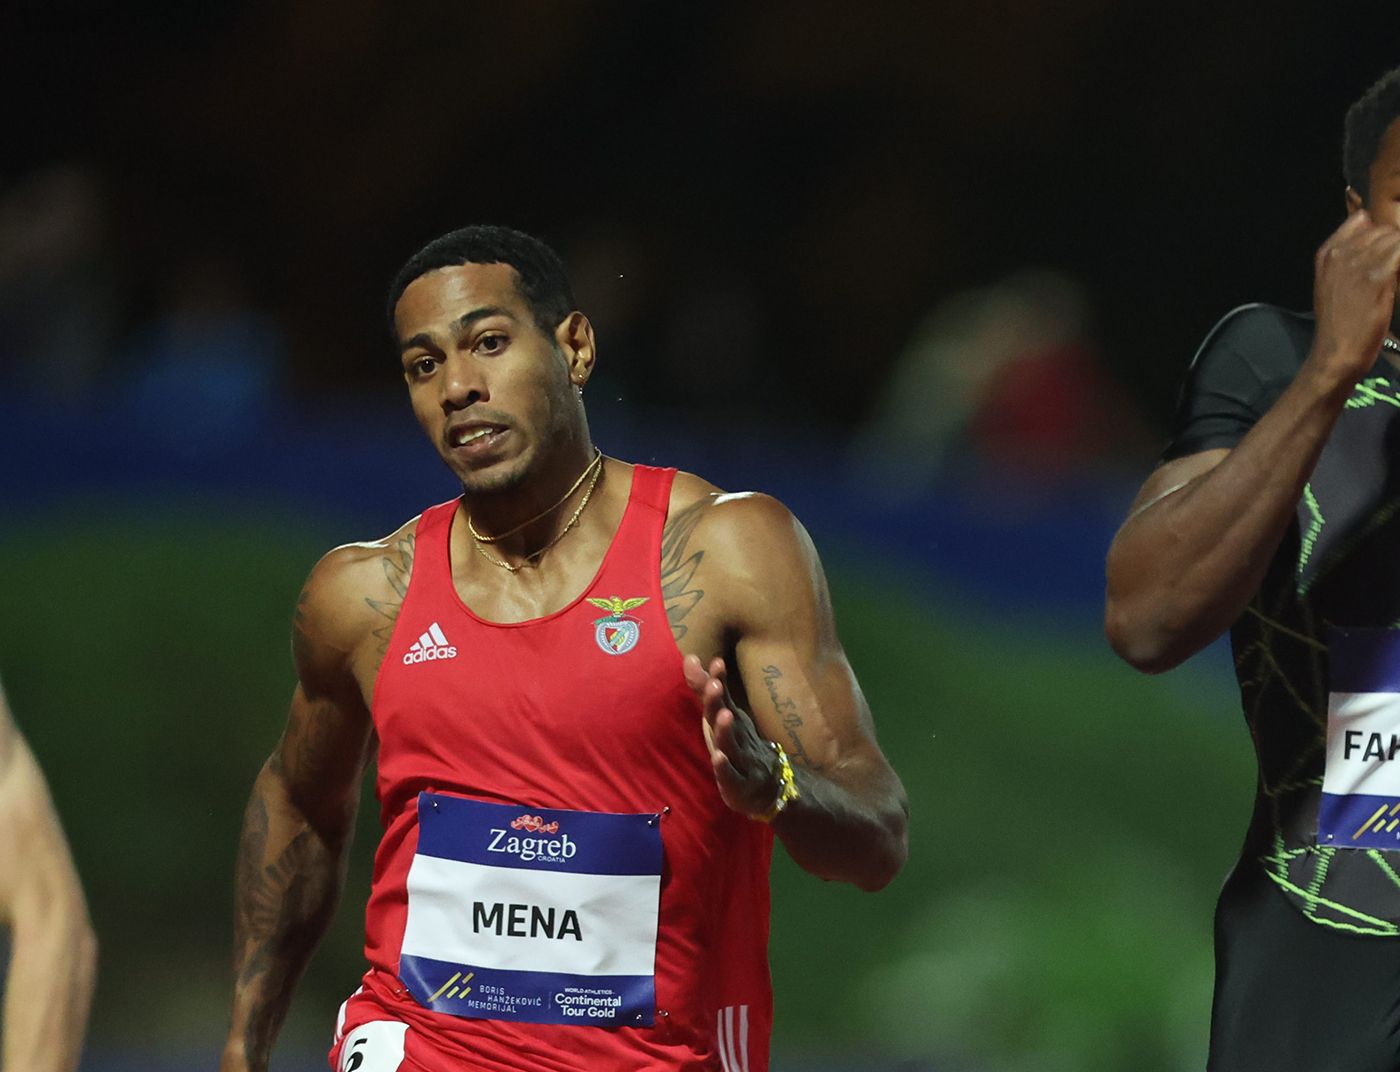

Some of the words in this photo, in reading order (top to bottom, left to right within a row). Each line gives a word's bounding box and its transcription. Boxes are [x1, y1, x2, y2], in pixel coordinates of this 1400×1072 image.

[403, 645, 457, 665] adidas
[487, 828, 577, 861] Zagreb
[537, 855, 566, 864] CROATIA
[472, 901, 583, 941] MENA
[479, 985, 505, 995] BORIS
[468, 1000, 517, 1013] MEMORIJAL
[487, 995, 542, 1006] HANŽEKOVIĆ
[554, 993, 622, 1007] Continental
[560, 1005, 586, 1017] Tour
[587, 1006, 616, 1018] Gold
